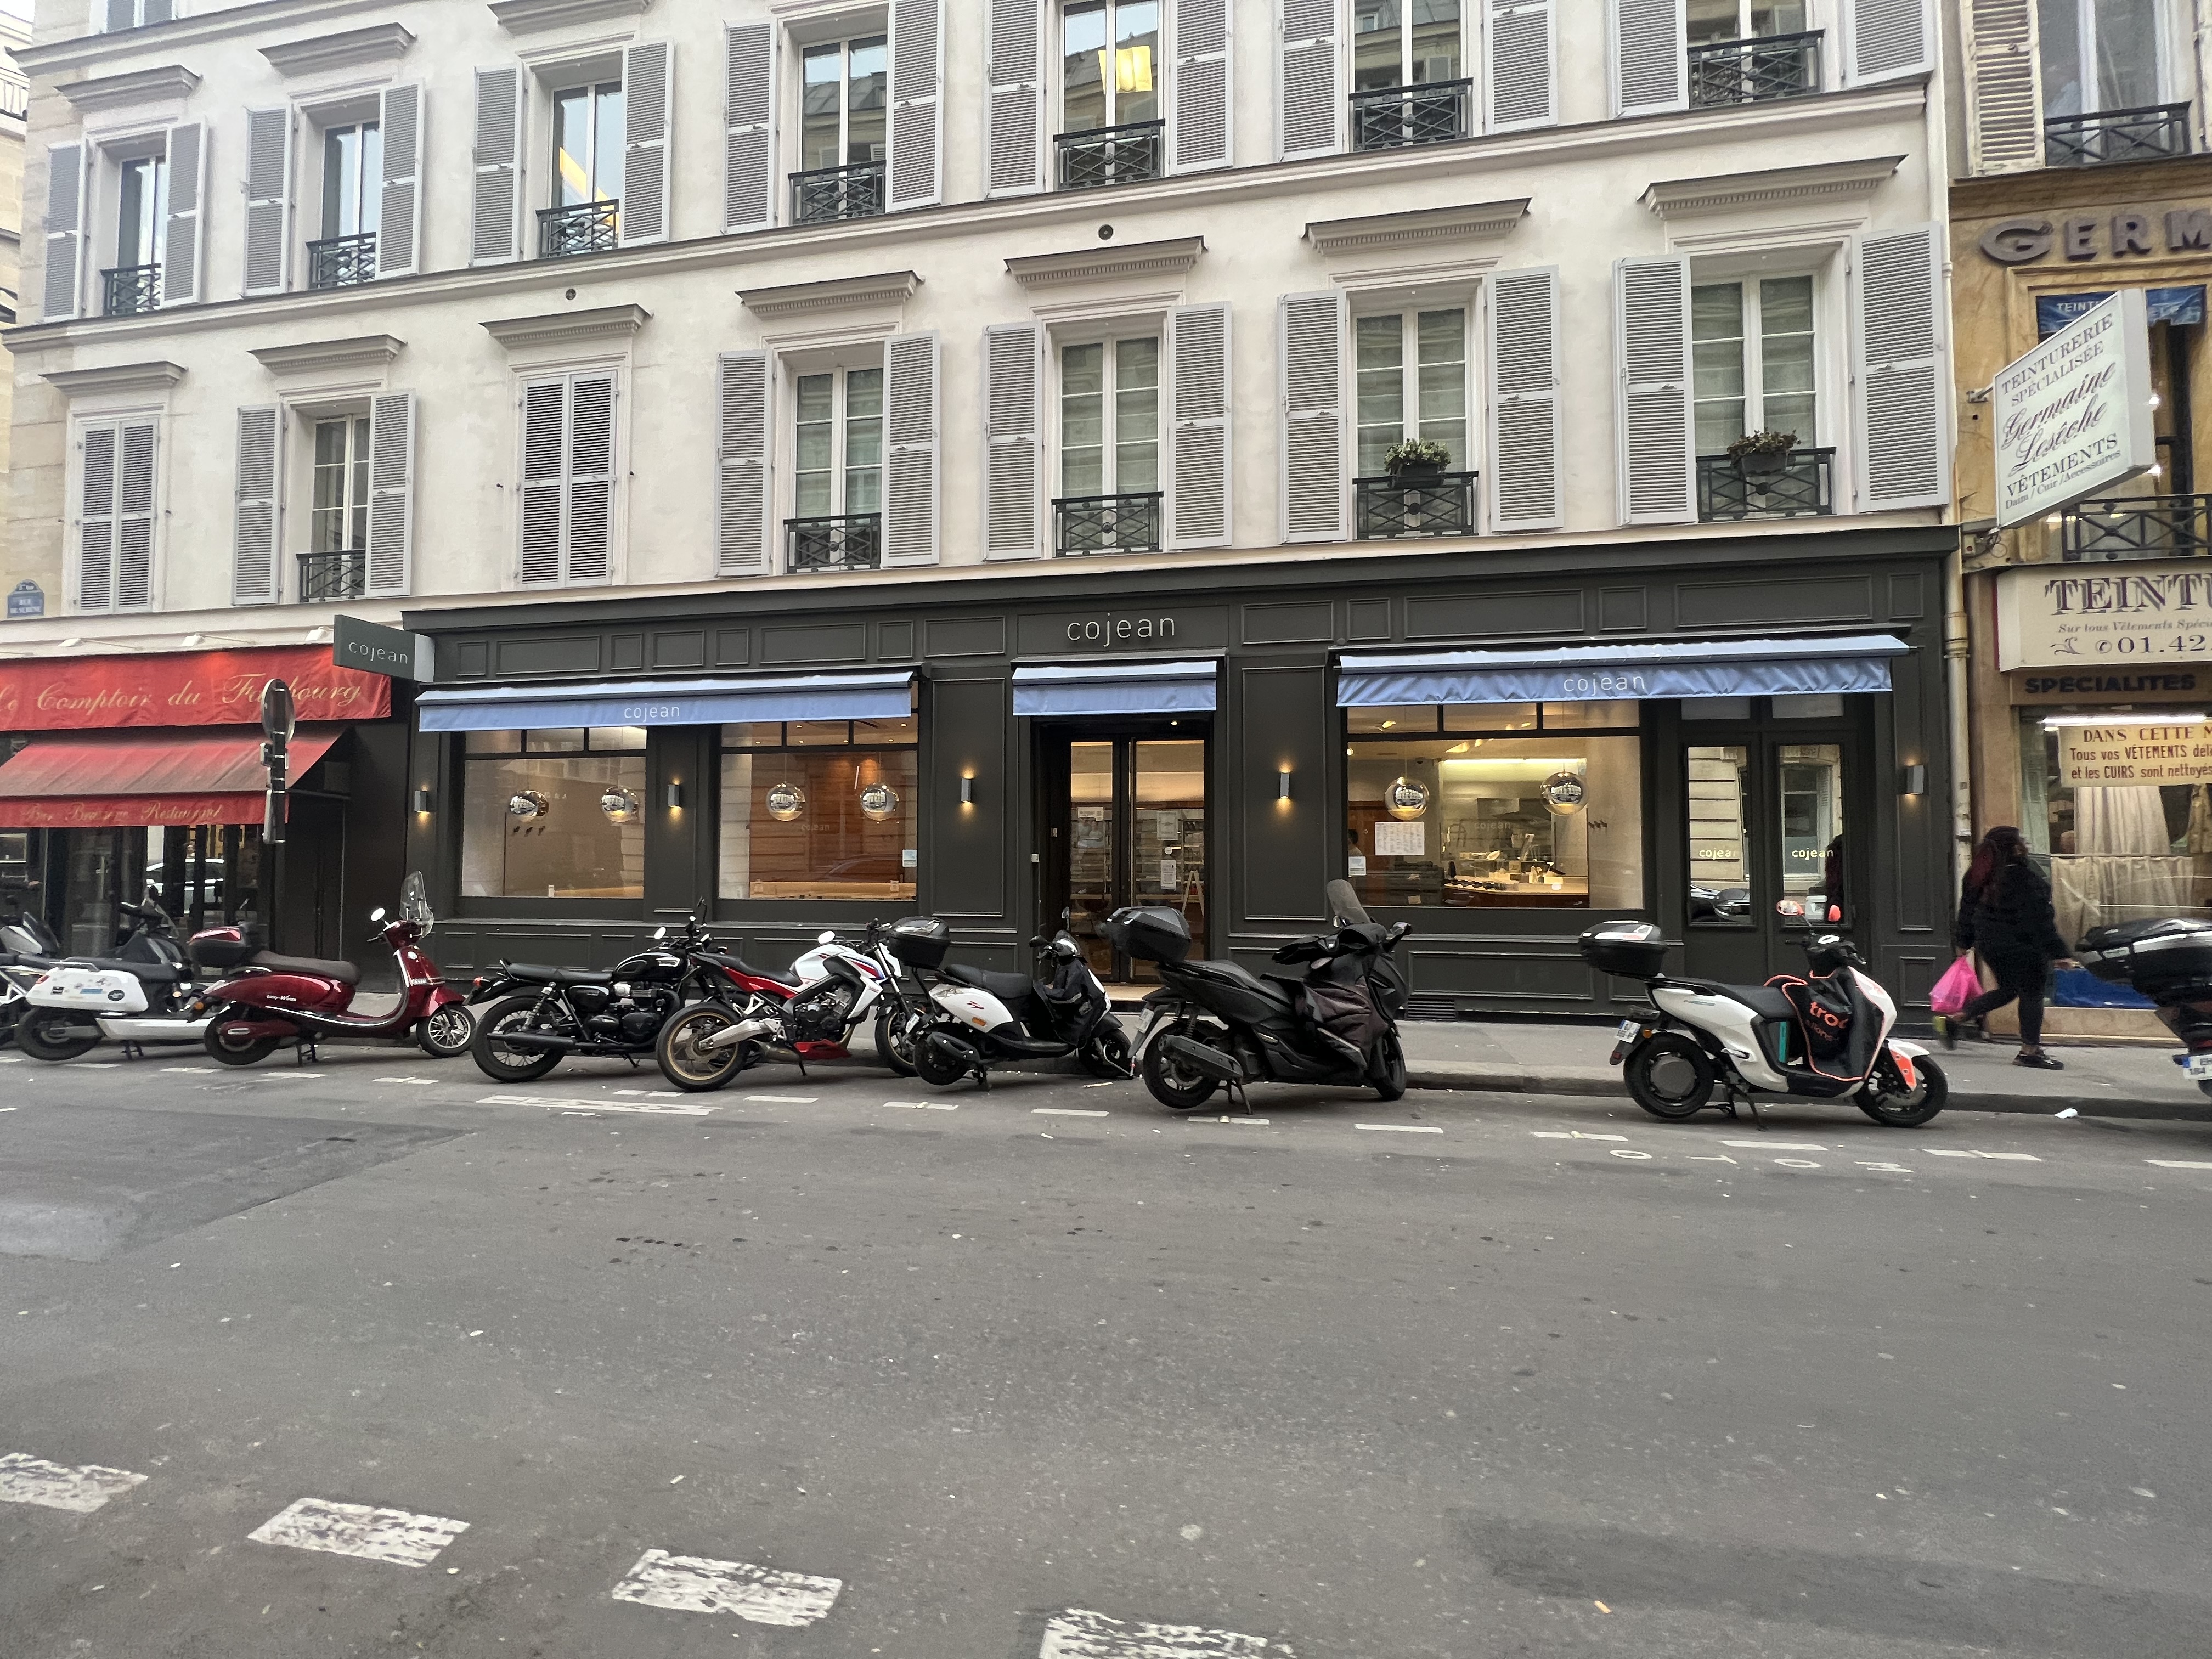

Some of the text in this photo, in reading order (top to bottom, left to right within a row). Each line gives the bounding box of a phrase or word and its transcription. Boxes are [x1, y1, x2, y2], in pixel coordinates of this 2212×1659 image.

[1980, 208, 2211, 266] GERM
[2057, 301, 2103, 313] TEINT
[2002, 313, 2113, 395] TEINTURERIE
[2012, 340, 2103, 407] SPÉCIALISÉE
[2001, 362, 2116, 450] Germaine
[2007, 433, 2118, 497] VÊTEMENTS
[2006, 494, 2029, 509] Daim
[2037, 481, 2057, 494] Cuir
[1067, 613, 1175, 647] cojean
[2058, 624, 2081, 633] Sur
[2085, 623, 2108, 632] tous
[2177, 618, 2212, 630] Spéci
[349, 641, 408, 664] cojean
[2118, 634, 2212, 654] 01.42
[37, 682, 153, 715] Comptoir
[168, 680, 199, 706] du
[222, 673, 362, 707] Fabourg
[1564, 672, 1645, 696] cojean
[2025, 674, 2195, 693] SPECIALITES
[624, 702, 680, 723] cojean
[2084, 729, 2127, 742] DANS
[2140, 726, 2194, 740] CETTE
[2070, 747, 2096, 761] Tous
[2102, 750, 2119, 760] vos
[2072, 768, 2081, 779] et
[2085, 767, 2100, 779] les
[2104, 766, 2134, 778] CUIRS
[2141, 765, 2163, 778] sont
[1791, 847, 1834, 860] cojean
